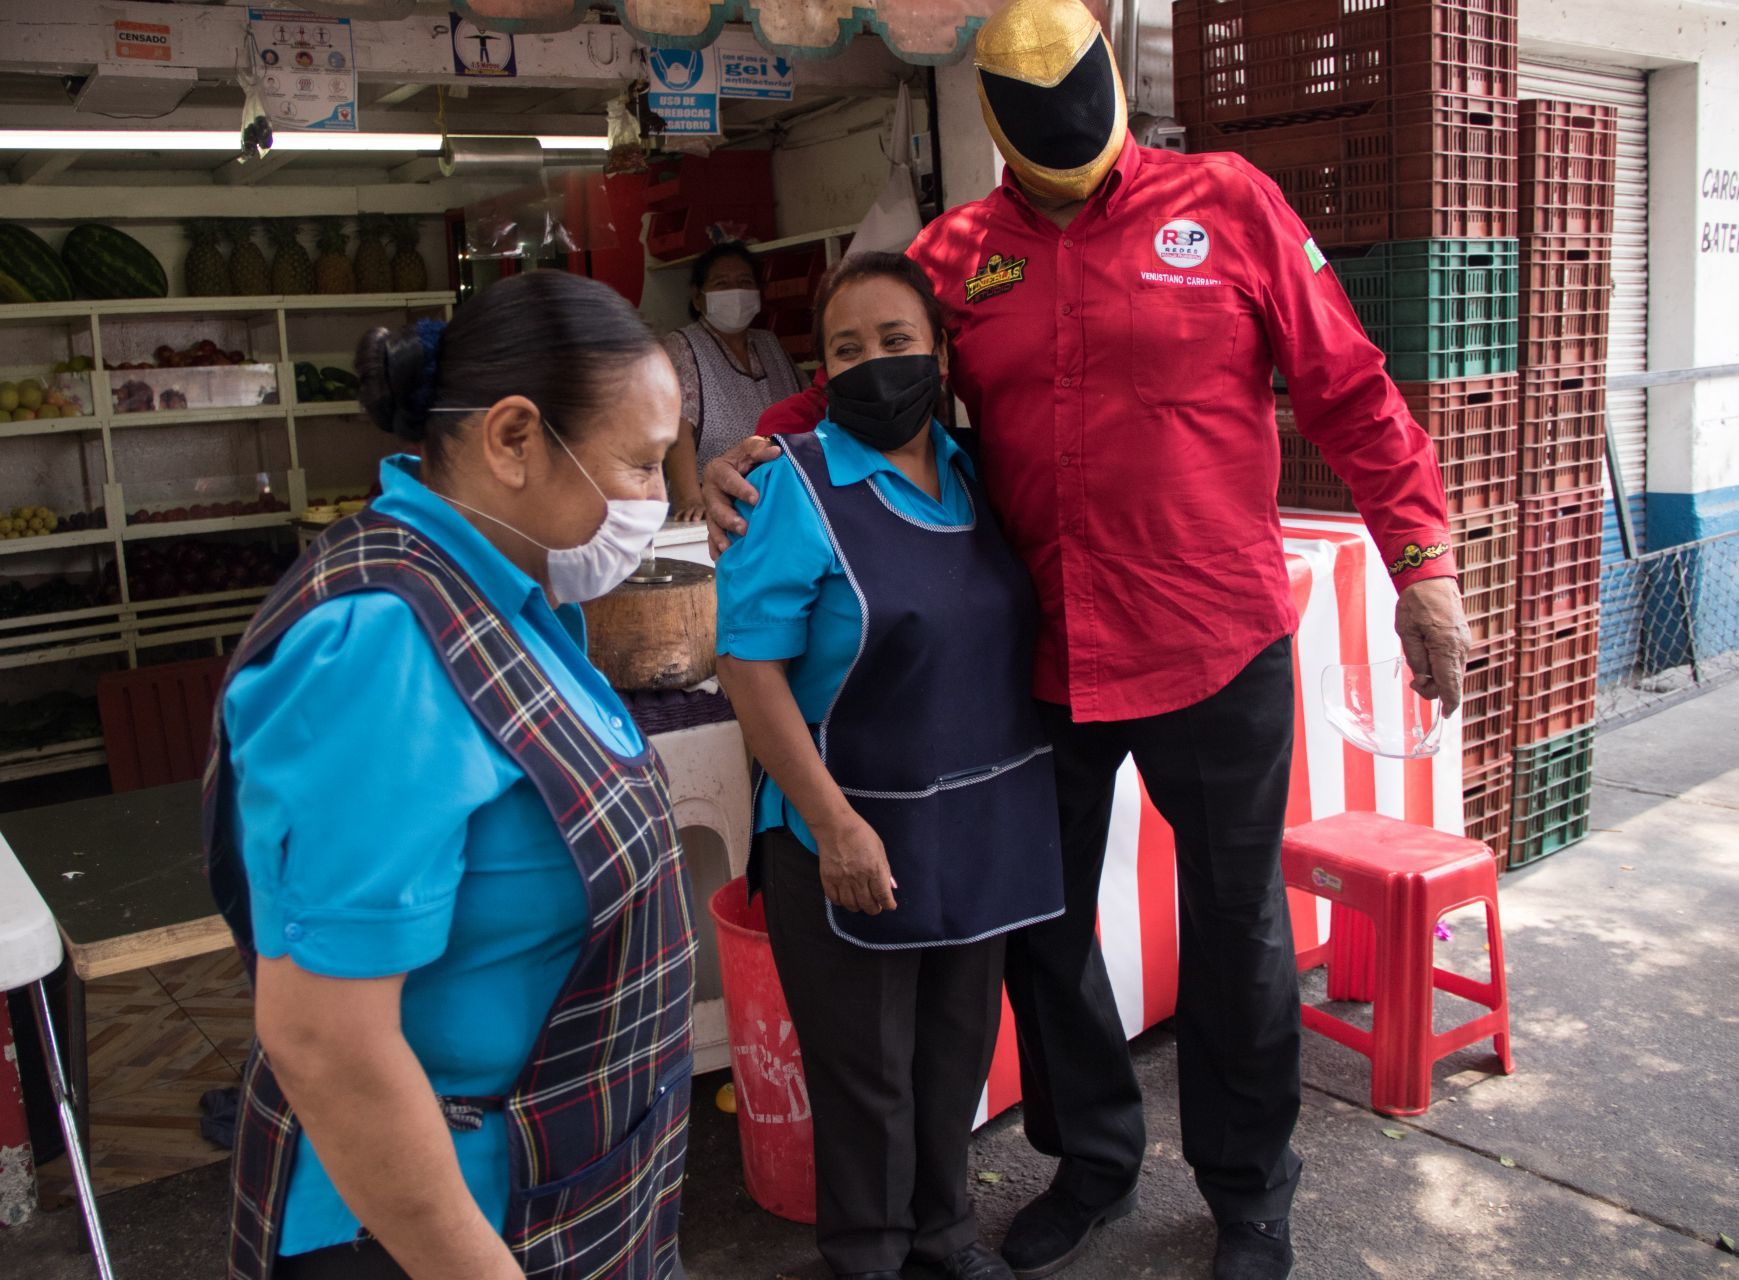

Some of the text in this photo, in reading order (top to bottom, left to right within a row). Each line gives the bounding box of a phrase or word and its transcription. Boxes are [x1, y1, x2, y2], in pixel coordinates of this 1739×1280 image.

[119, 32, 167, 44] CENSADO
[725, 63, 767, 77] gel
[725, 77, 792, 87] antibacterial
[659, 96, 696, 105] USO DE
[651, 108, 710, 118] BREBOCAS
[665, 120, 710, 130] GATORIO
[1702, 168, 1739, 200] CARG
[1162, 229, 1205, 246] RSP
[1701, 222, 1739, 253] BATE
[969, 266, 1021, 294] TINIEBLAS
[1141, 271, 1184, 284] VENUSTIANO
